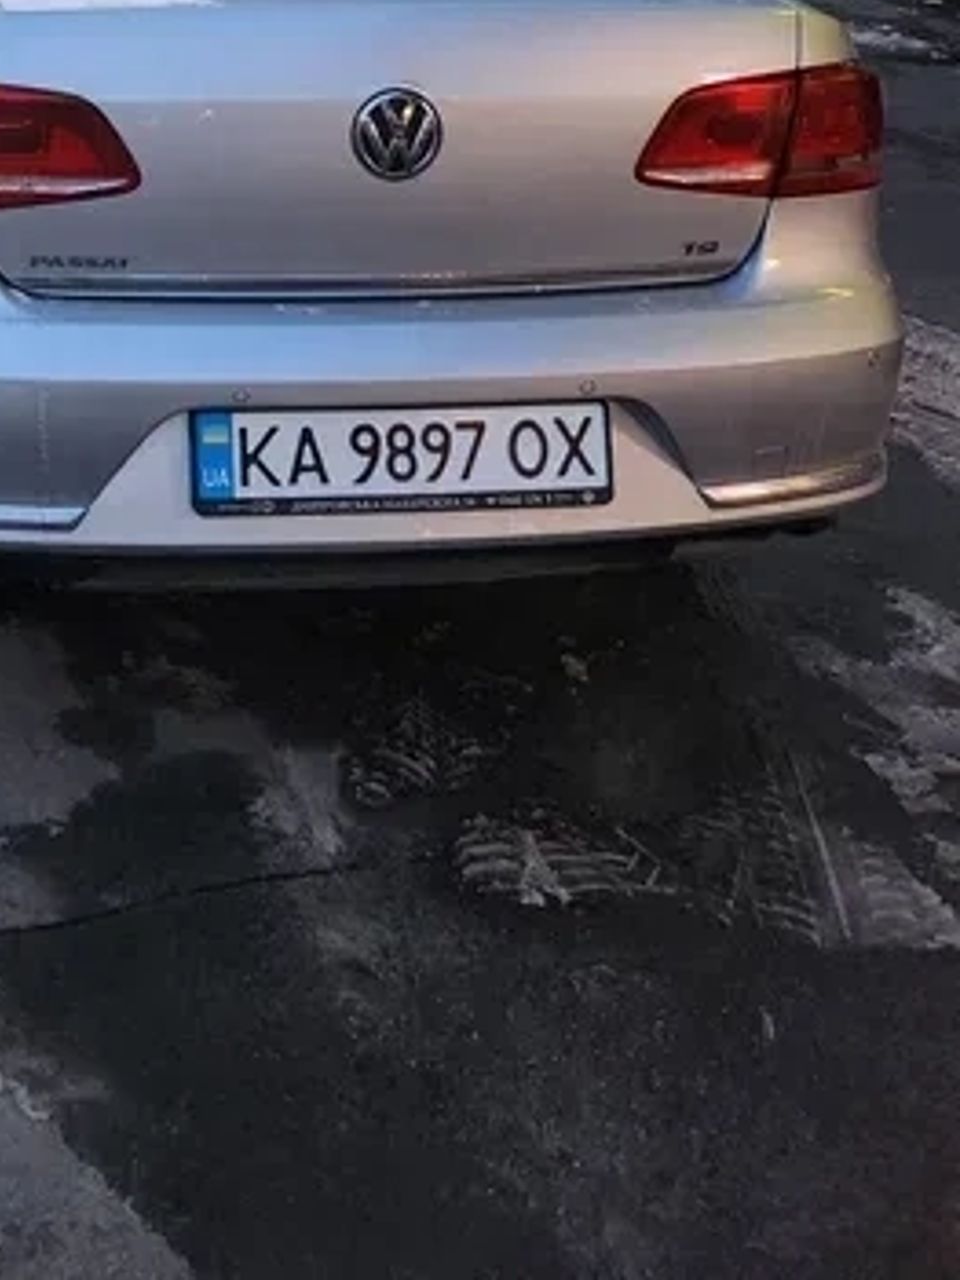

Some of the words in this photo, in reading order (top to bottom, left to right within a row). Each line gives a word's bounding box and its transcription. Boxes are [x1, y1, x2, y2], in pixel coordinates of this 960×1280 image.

[29, 255, 131, 269] PASSAT
[241, 426, 329, 487] KA
[349, 421, 486, 485] 9897
[508, 417, 596, 480] OX
[201, 468, 230, 488] UA
